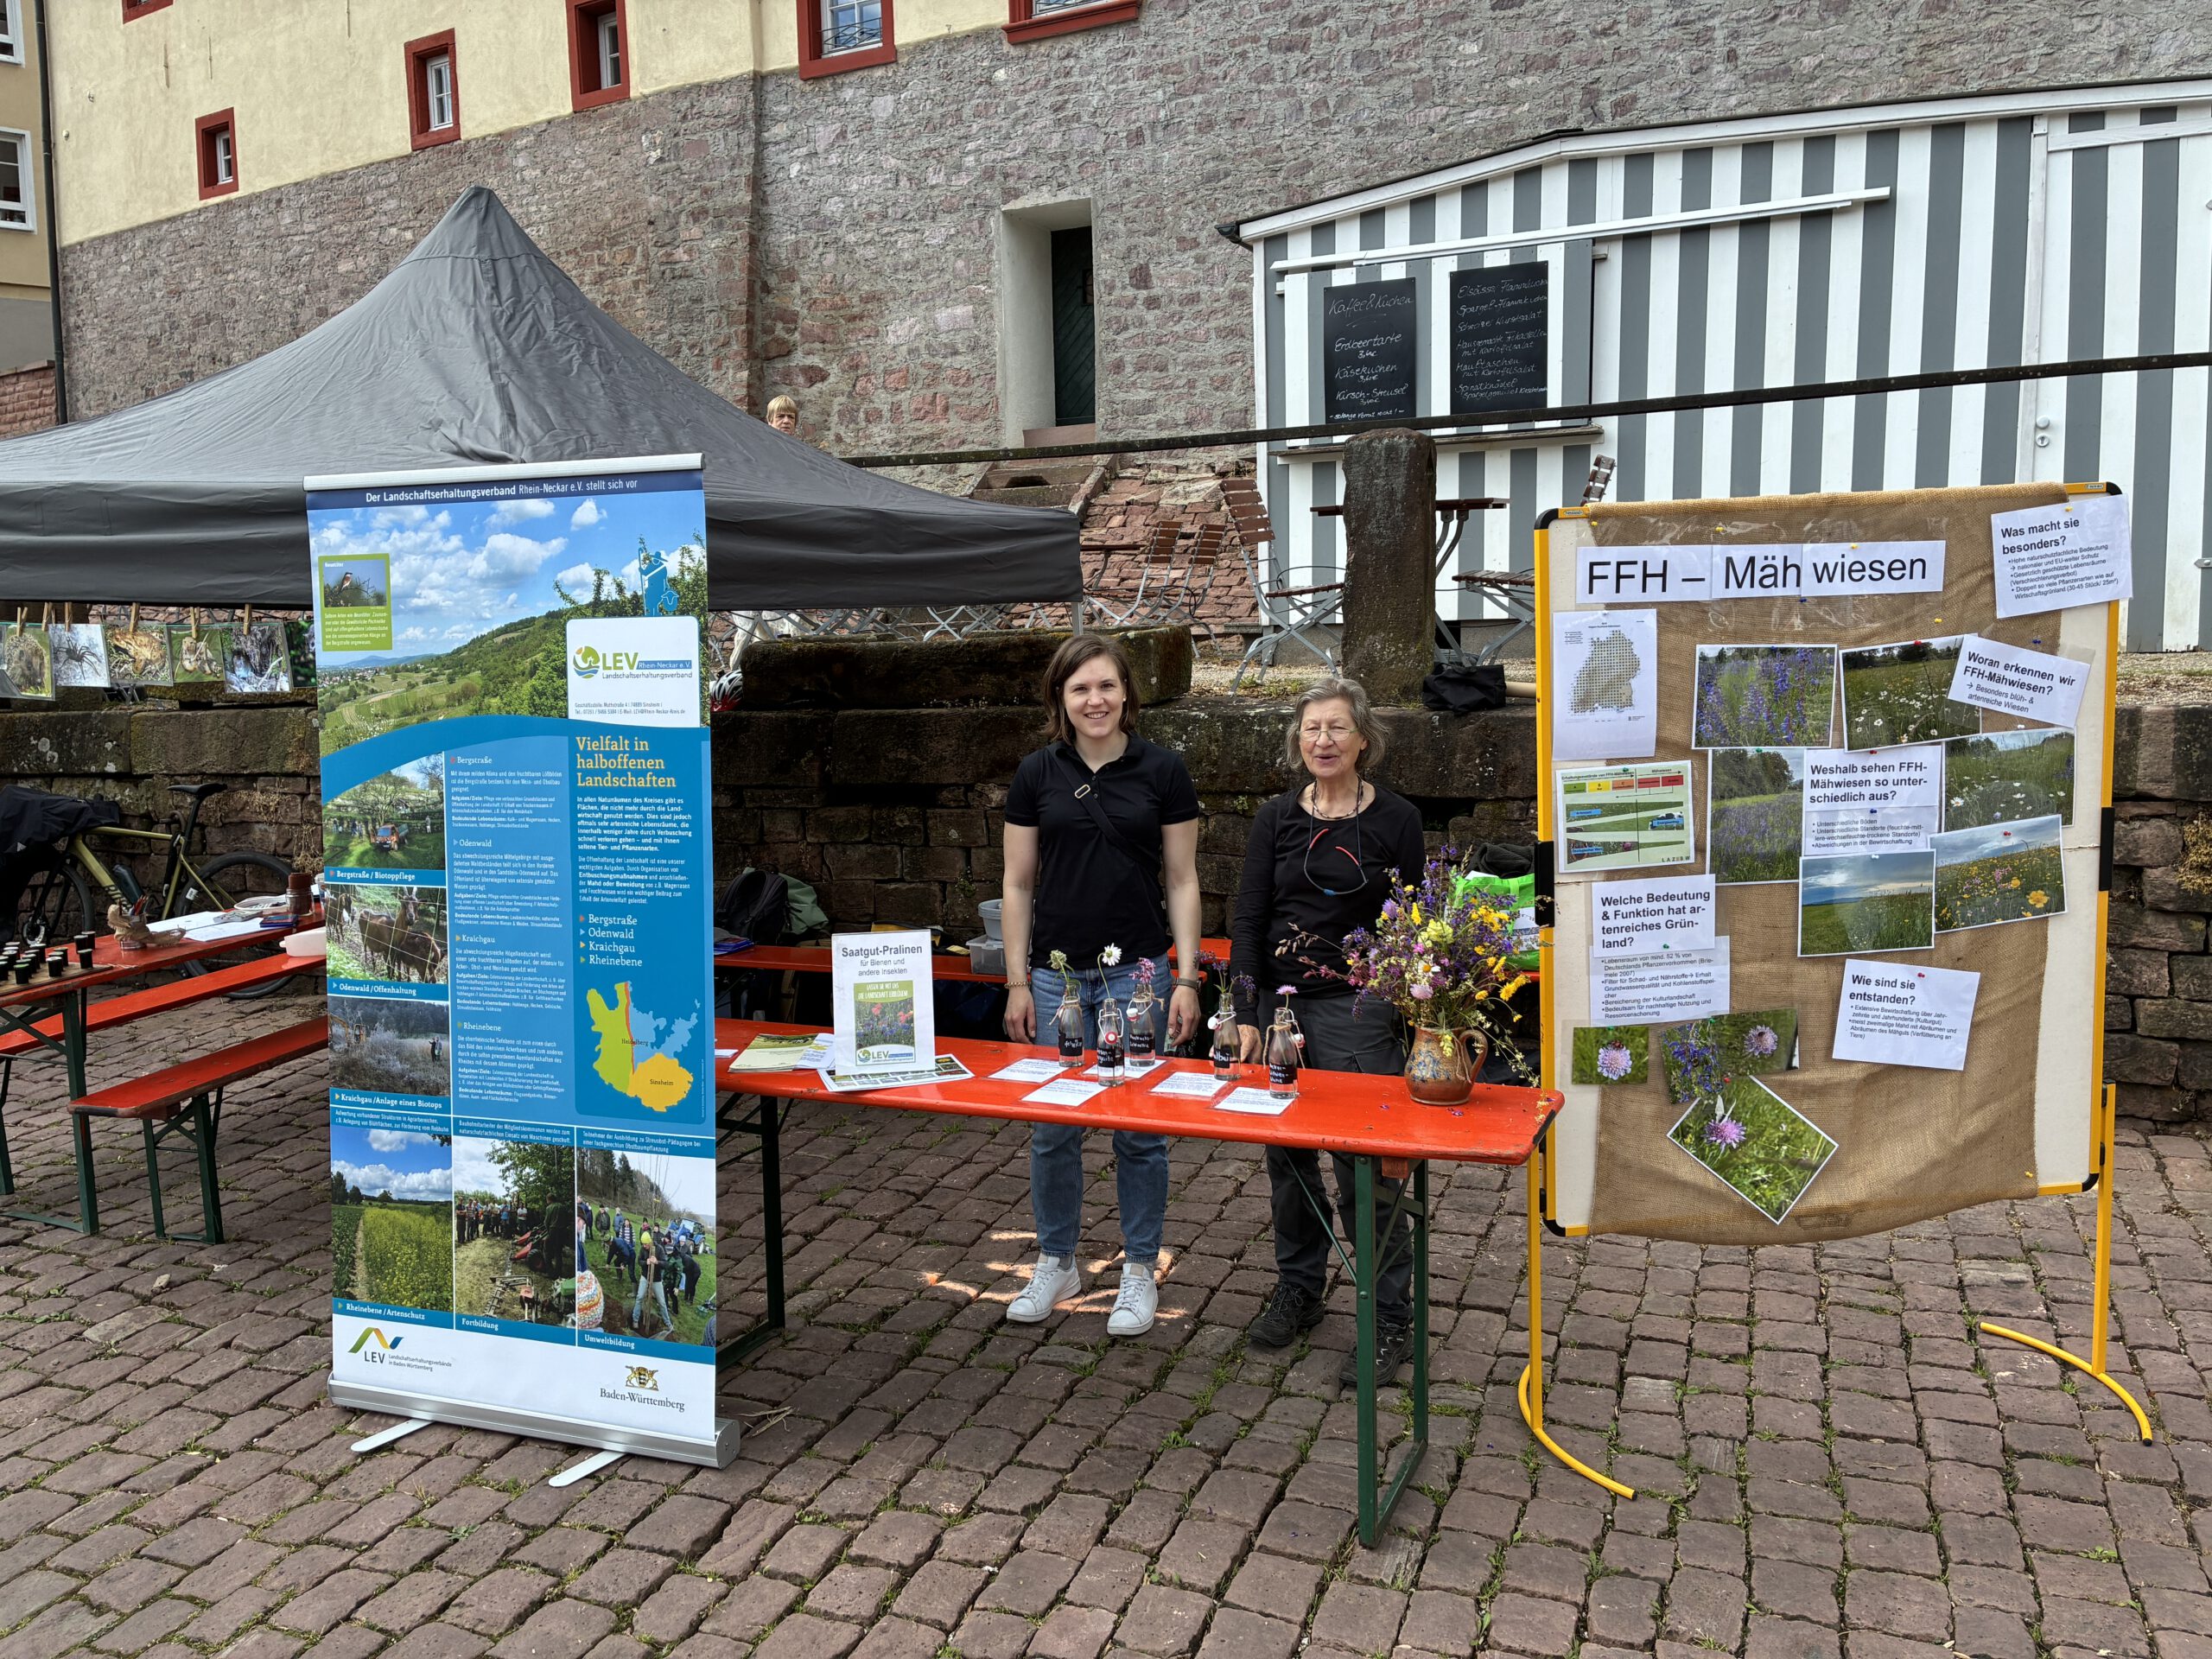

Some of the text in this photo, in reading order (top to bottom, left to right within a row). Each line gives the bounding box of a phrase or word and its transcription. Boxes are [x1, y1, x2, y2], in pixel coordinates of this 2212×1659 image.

[365, 493, 380, 502] Der
[384, 485, 516, 501] Landschaftserhaltungsverband
[519, 483, 568, 494] Rhein-Neckar
[586, 480, 605, 491] stellt
[607, 479, 623, 490] sich
[626, 480, 638, 488] vor
[2001, 518, 2080, 538] Was macht sie
[2002, 535, 2067, 555] besonders?
[2080, 543, 2108, 553] Bedeutung
[2013, 558, 2106, 579] Gesetzlich geschützte Lebensräume
[2018, 562, 2043, 570] nationaler
[1588, 560, 1668, 594] FFH
[1726, 555, 1802, 589] Mäh
[1813, 555, 1926, 583] wiesen
[602, 652, 638, 671] LEV
[1967, 652, 2075, 686] Woran erkennen wir
[1963, 665, 2053, 696] FFH-Mähwiesen?
[1975, 684, 2012, 698] Besonders
[1967, 693, 2029, 713] artenreiche Wiesen
[575, 736, 649, 751] Vielfalt in
[457, 756, 493, 765] Bergstraße
[576, 753, 664, 769] halboffenen
[1810, 762, 1928, 774] Weshalb sehen FFH-
[577, 772, 677, 787] Landschaften
[1810, 779, 1871, 789] Mähwiesen
[1892, 777, 1928, 786] unter-
[1809, 791, 1897, 803] schiedlich aus?
[337, 871, 370, 880] Bergstraße
[375, 872, 416, 880] Biotoppflege
[1601, 891, 1710, 906] Welche Bedeutung
[588, 914, 638, 926] Bergstraße
[1602, 911, 1610, 921] &
[1614, 907, 1664, 919] Funktion
[1668, 906, 1686, 916] hat
[588, 928, 634, 938] Odenwald
[1602, 919, 1699, 934] tenreiches Grün-
[462, 935, 495, 944] Kraichgau
[1602, 937, 1634, 948] land?
[589, 941, 635, 954] Kraichgau
[842, 944, 923, 958] Saatgut-Pralinen
[589, 955, 643, 967] Rheinebene
[340, 983, 369, 992] Odenwald
[1852, 975, 1916, 989] Wie sind sie
[1849, 991, 1916, 1005] entstanden?
[463, 1022, 501, 1032] Rheinebene
[872, 1051, 889, 1059] LEV
[341, 1093, 372, 1103] Kraichgau
[417, 1100, 442, 1109] Biotops
[346, 1303, 383, 1314] Rheinebene
[461, 1318, 499, 1332] Fortbildung
[585, 1334, 635, 1349] Umweltbildung
[364, 1351, 385, 1363] LEV
[407, 1362, 433, 1372] Württemberg
[600, 1388, 685, 1413] Baden-Württemberg
